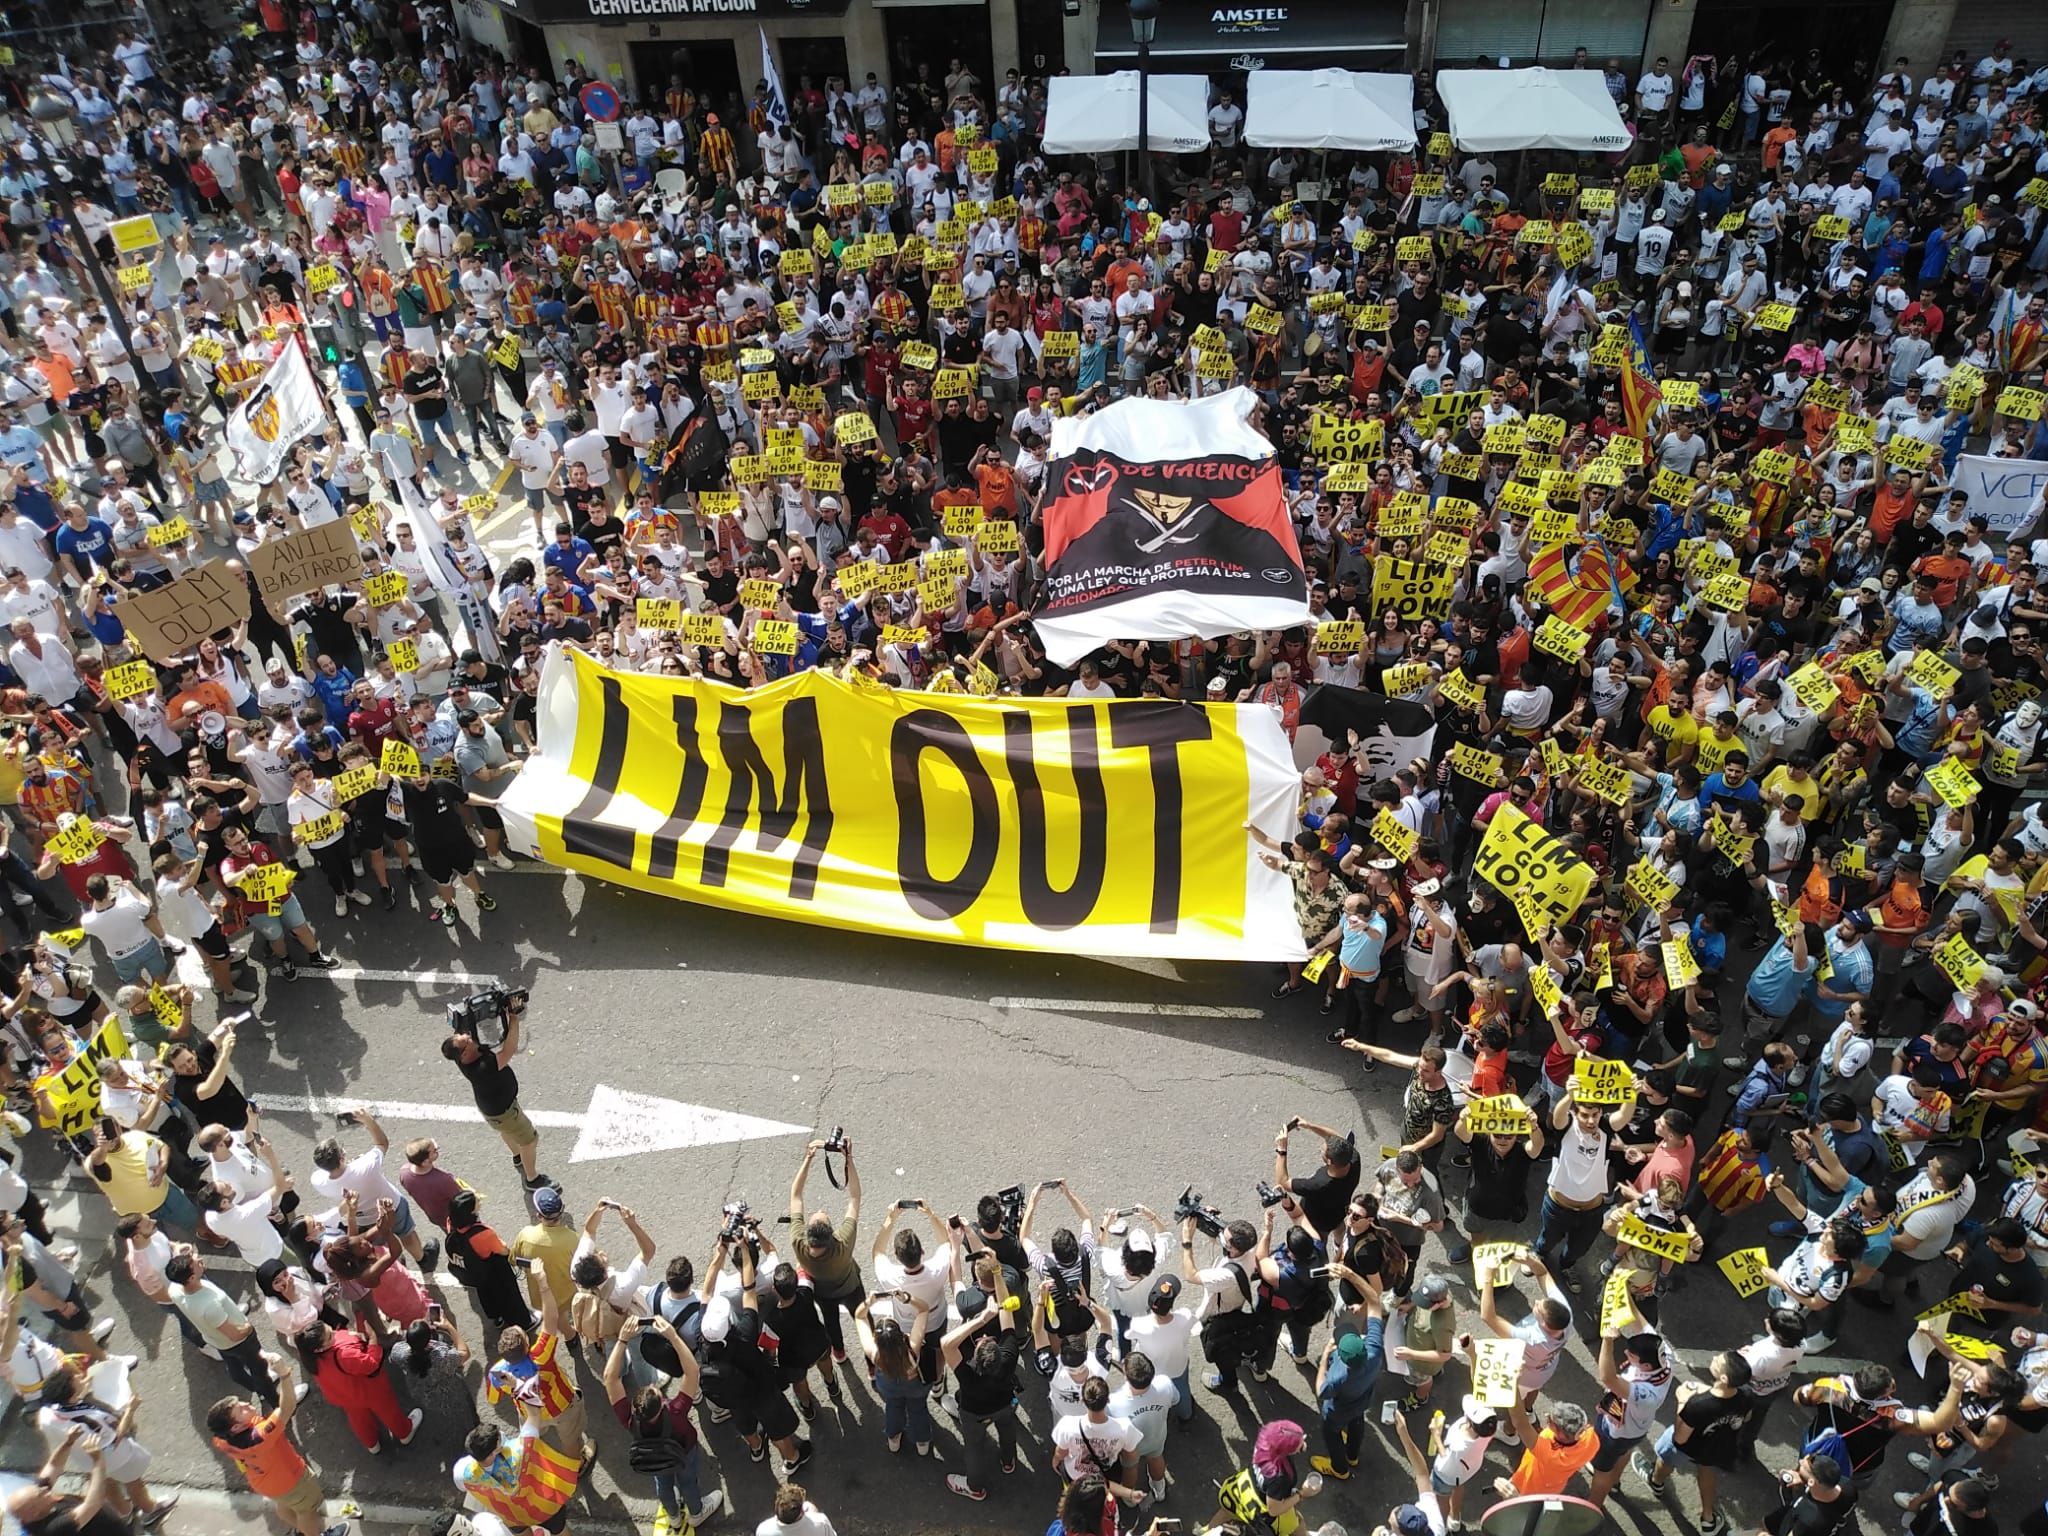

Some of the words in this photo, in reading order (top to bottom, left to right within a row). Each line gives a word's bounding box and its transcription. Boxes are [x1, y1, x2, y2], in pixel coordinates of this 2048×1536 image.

[1212, 8, 1287, 22] AMSTEL
[1592, 136, 1624, 144] AMSTEL
[1823, 216, 1842, 225] LIM
[1815, 230, 1844, 239] HOME
[1405, 238, 1424, 246] LIM
[1644, 241, 1661, 257] 19
[313, 266, 329, 277] LIM
[937, 286, 956, 294] LIM
[1051, 334, 1071, 342] LIM
[1046, 348, 1076, 356] HOME
[749, 374, 768, 384] LIM
[746, 388, 776, 398] HOME
[1433, 394, 1482, 414] LIM
[843, 417, 864, 429] LIM
[841, 430, 874, 443] HOME
[1333, 430, 1360, 442] GO
[1493, 426, 1517, 436] LIM
[1484, 442, 1522, 452] HOME
[1897, 438, 1924, 452] LIM
[775, 448, 796, 457] LIM
[1316, 442, 1381, 463] HOME
[1763, 452, 1787, 465] LIM
[770, 463, 802, 473] HOME
[1884, 454, 1925, 470] HOME
[1336, 465, 1360, 474] LIM
[1751, 464, 1790, 483] HOME
[1328, 482, 1366, 490] HOME
[1388, 507, 1411, 518] LIM
[985, 523, 1008, 534] LIM
[1382, 525, 1420, 536] HOME
[272, 527, 343, 571] ANIL
[980, 540, 1016, 551] HOME
[263, 553, 361, 594] BASTARDO
[1048, 574, 1071, 588] POR
[1074, 570, 1091, 582] LA
[1094, 566, 1151, 578] MARCHA
[1155, 562, 1172, 572] DE
[1174, 558, 1216, 568] PETER
[1390, 560, 1445, 580] LIM
[373, 573, 396, 588] LIM
[1048, 590, 1056, 600] Y
[1058, 583, 1085, 596] UNA
[1088, 576, 1112, 590] LEY
[1119, 576, 1146, 586] QUE
[1150, 566, 1210, 584] PROTEJA
[1212, 566, 1222, 576] A
[1224, 570, 1251, 578] LOS
[1717, 574, 1742, 590] LIM
[372, 586, 406, 605] HOME
[1402, 583, 1434, 594] GO
[136, 570, 231, 624] LIM
[1704, 590, 1742, 608] HOME
[646, 600, 671, 610] LIM
[1376, 597, 1450, 617] HOME
[159, 594, 242, 646] OUT
[640, 618, 677, 629] HOME
[689, 616, 712, 626] LIM
[763, 622, 789, 633] LIM
[1326, 623, 1354, 632] LIM
[684, 634, 721, 644] HOME
[1318, 642, 1360, 650] HOME
[756, 642, 794, 653] HOME
[112, 662, 139, 680] LIM
[1923, 655, 1950, 676] LIM
[112, 678, 153, 698] HOME
[468, 682, 498, 690] ALENCIA
[1810, 670, 1832, 693] LIM
[1908, 668, 1944, 696] HOME
[1788, 676, 1825, 712] HOME
[1462, 748, 1490, 764] LIM
[1702, 743, 1720, 758] LIM
[1451, 761, 1496, 785] HOME
[1596, 764, 1624, 782] LIM
[1584, 774, 1625, 802] HOME
[562, 675, 834, 901] LIM
[891, 700, 1212, 934] OUT
[57, 823, 82, 848] LIM
[64, 832, 102, 861] HOME
[1511, 819, 1582, 876] LIM
[1516, 851, 1548, 880] GO
[62, 1036, 111, 1094] LIM
[1588, 1064, 1622, 1078] LIM
[1578, 1088, 1633, 1100] HOME
[1479, 1098, 1512, 1112] LIM
[1471, 1119, 1526, 1130] HOME
[1622, 1228, 1683, 1258] HOME
[1476, 1344, 1493, 1402] HOME
[1129, 1404, 1164, 1418] ANOLETE
